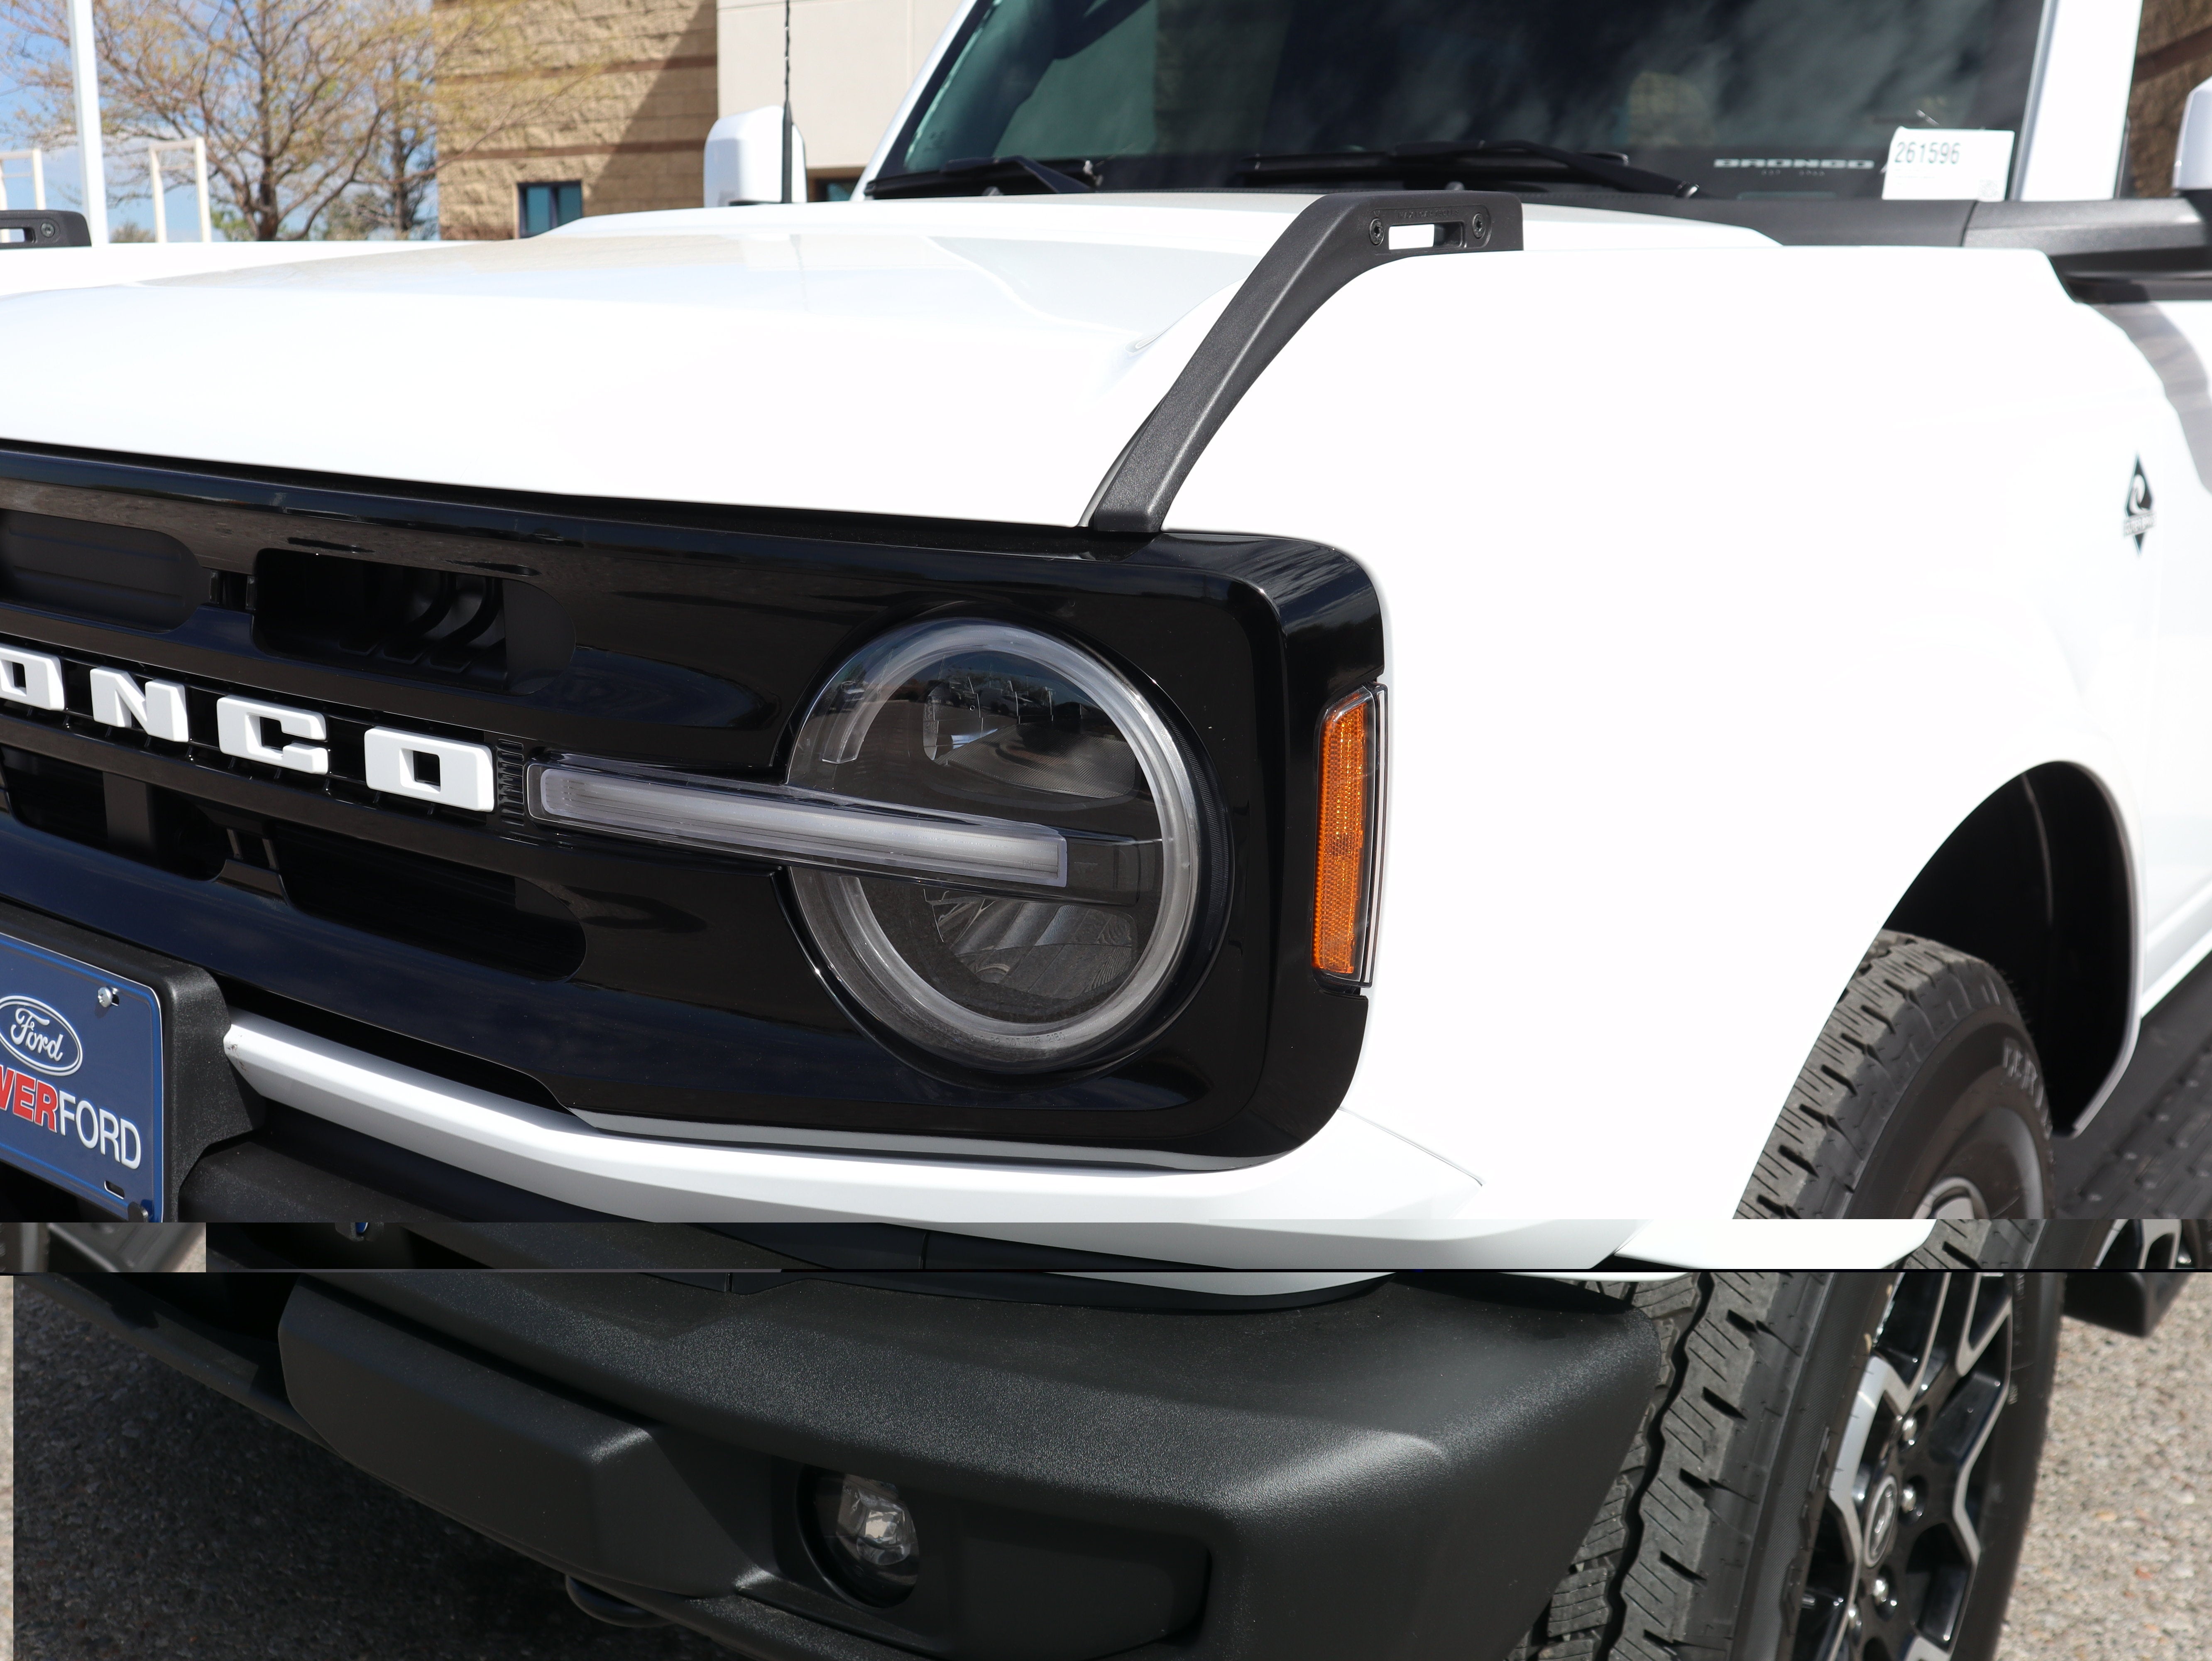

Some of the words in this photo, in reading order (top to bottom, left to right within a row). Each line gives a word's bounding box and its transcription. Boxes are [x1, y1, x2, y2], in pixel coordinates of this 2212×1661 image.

[1894, 141, 1961, 164] 261596
[1714, 158, 1875, 169] BRONCO
[10, 1007, 63, 1061] Ford
[1006, 1038, 1020, 1046] DOT
